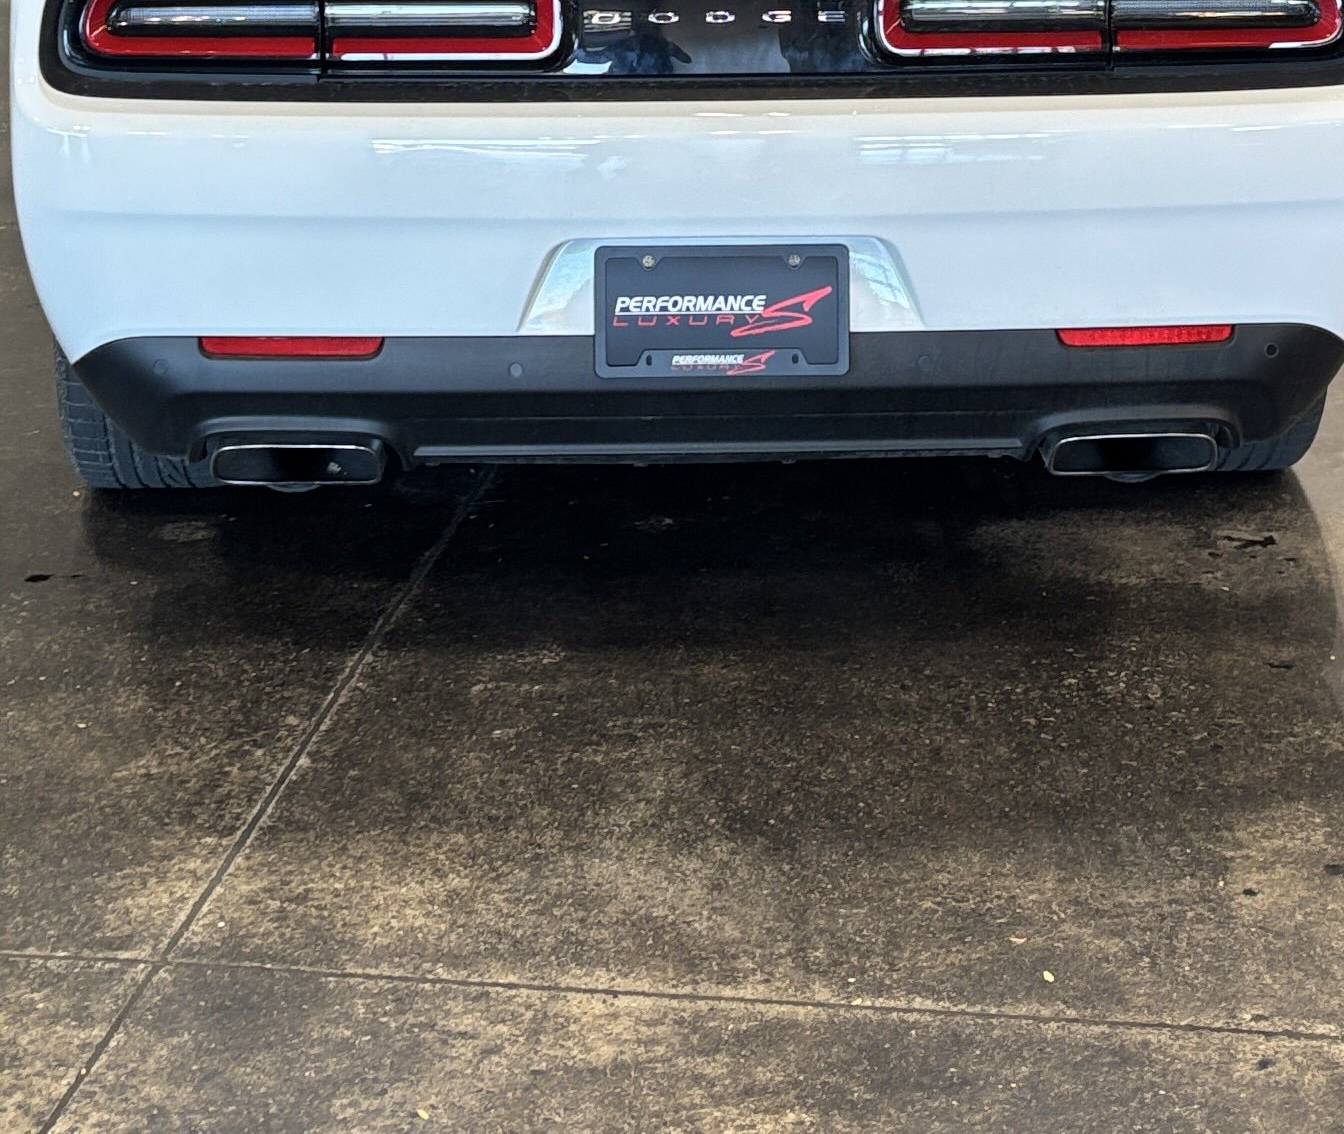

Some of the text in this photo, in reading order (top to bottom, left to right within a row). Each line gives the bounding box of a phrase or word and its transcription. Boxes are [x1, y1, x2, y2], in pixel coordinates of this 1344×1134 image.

[590, 9, 847, 25] DODGE
[613, 294, 767, 313] PERFORMANCE
[612, 314, 761, 327] LUXURY
[671, 353, 745, 365] PERFORMANCE
